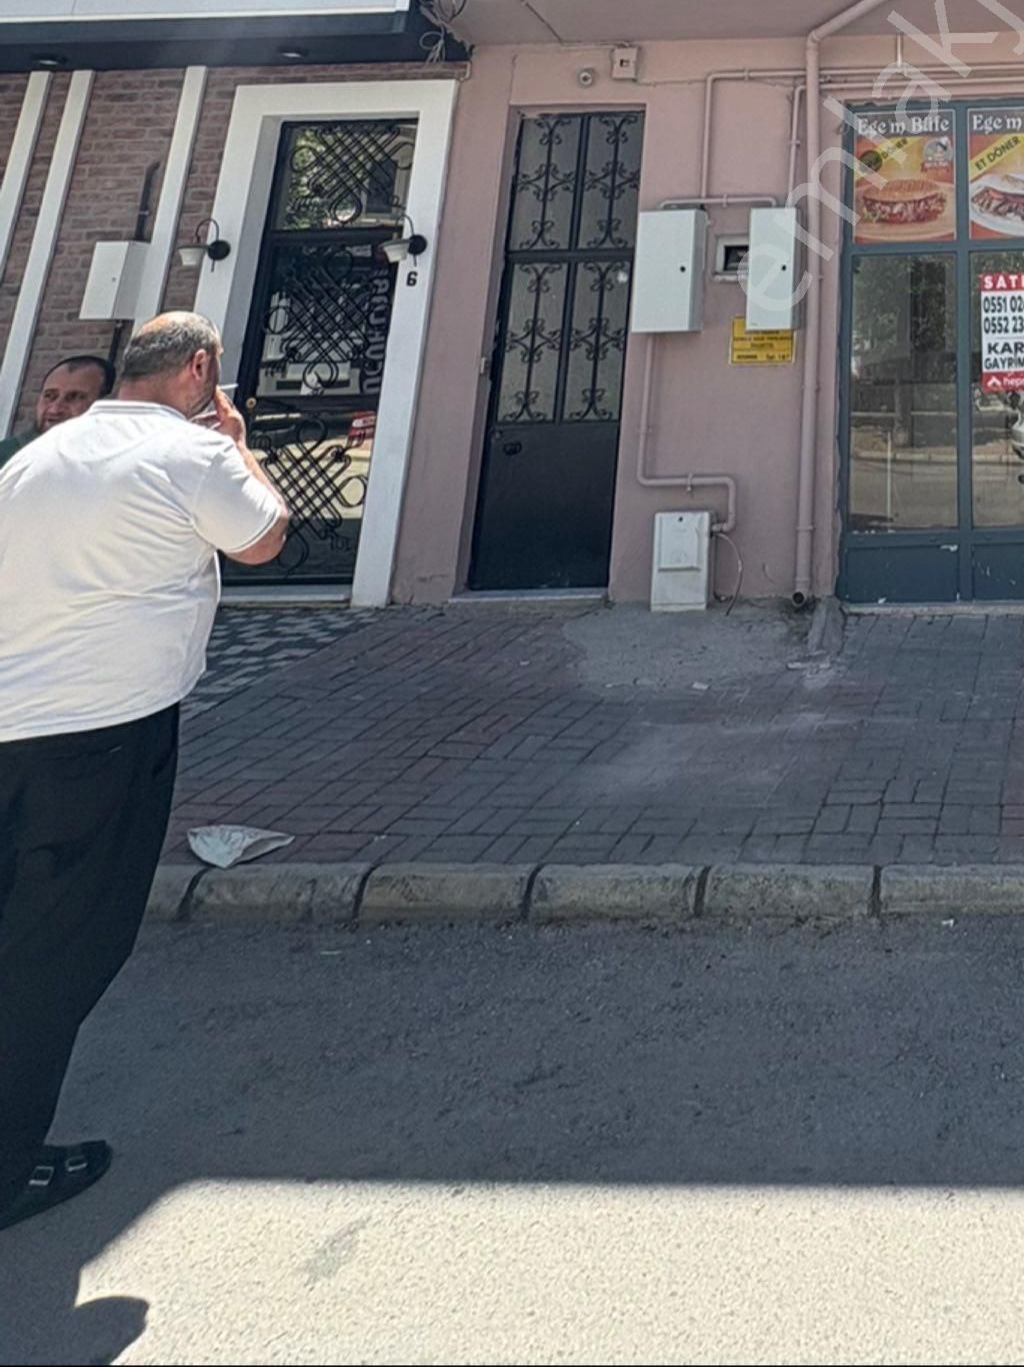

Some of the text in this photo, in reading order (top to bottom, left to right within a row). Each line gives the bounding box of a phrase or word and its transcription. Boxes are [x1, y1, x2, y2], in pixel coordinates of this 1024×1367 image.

[974, 158, 987, 171] ET
[987, 136, 1021, 163] DÖNER
[406, 270, 419, 288] 6
[983, 295, 1008, 314] 0551
[983, 316, 1009, 334] 0552
